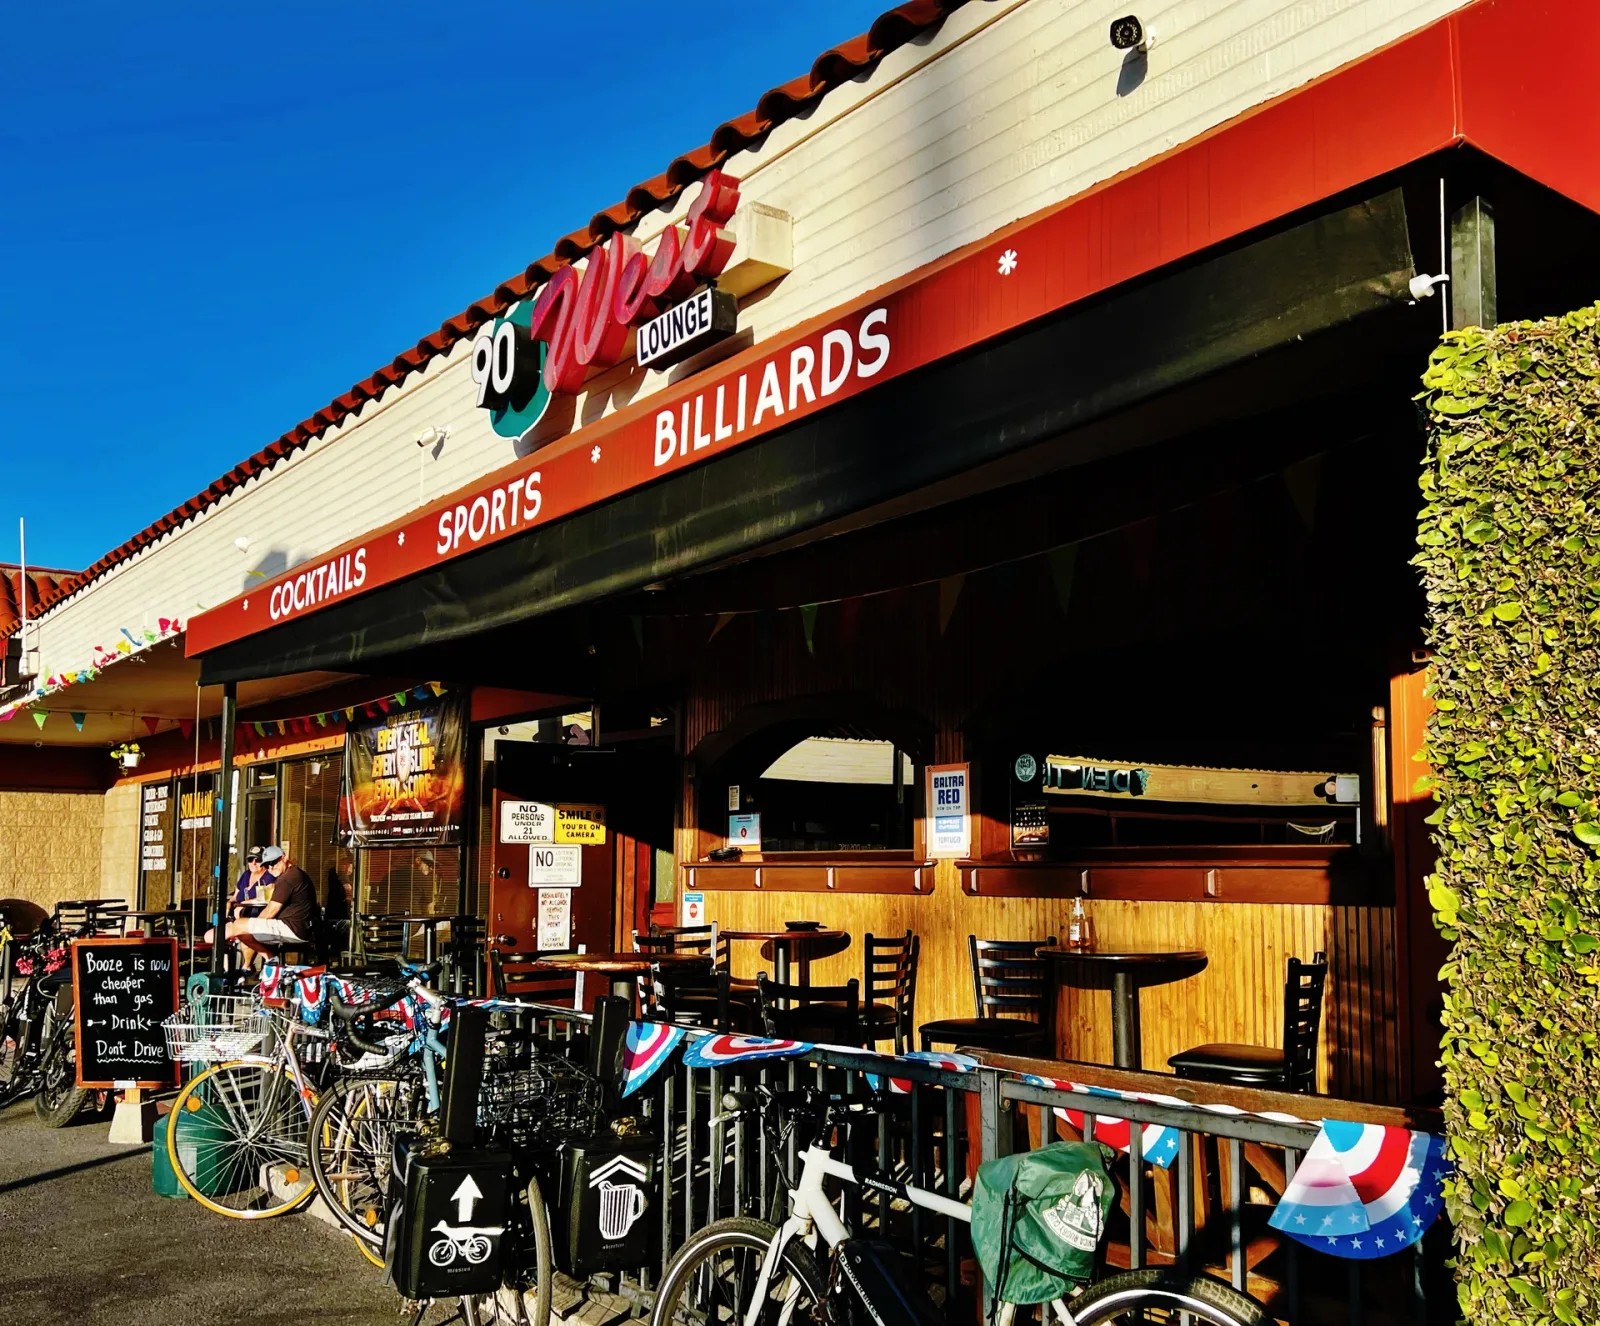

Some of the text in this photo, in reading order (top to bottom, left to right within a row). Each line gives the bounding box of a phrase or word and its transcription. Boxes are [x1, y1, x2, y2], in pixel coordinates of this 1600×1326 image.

[471, 170, 739, 408] 90 West
[638, 292, 711, 361] LOUNGE
[269, 308, 890, 620] COCKTAILS SPORTS BILLIARDS
[377, 721, 430, 752] EVERY STEAL
[374, 773, 433, 801] EVERY SCORE
[933, 775, 964, 788] BALTRA
[938, 788, 960, 805] RED
[511, 813, 545, 821] PERSONS
[519, 805, 538, 813] NO
[558, 810, 591, 820] SMILE
[536, 851, 554, 867] NO
[85, 951, 170, 974] Booze is now
[101, 976, 145, 994] cheaper
[93, 992, 154, 1011] than gas
[111, 1014, 149, 1031] Drink
[134, 1040, 164, 1058] Drive
[864, 1177, 898, 1195] RADMISSION
[844, 1263, 880, 1319] POWER BIKES
